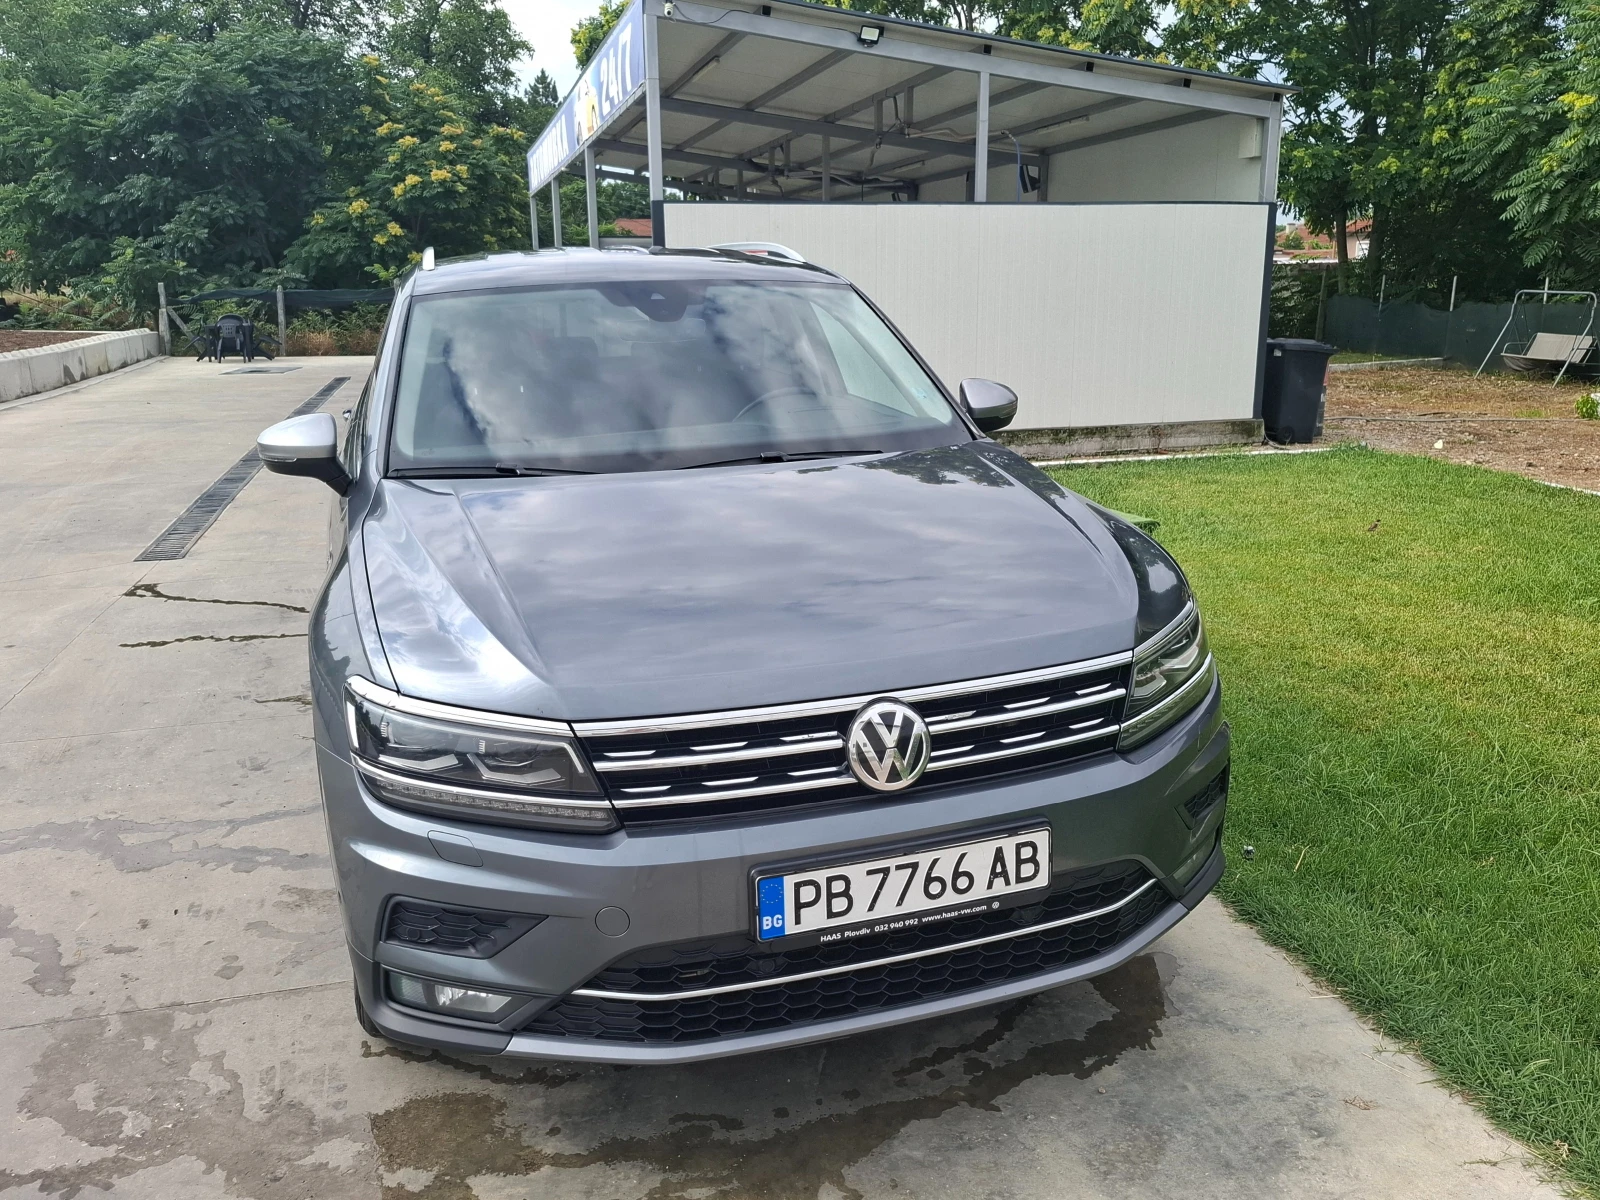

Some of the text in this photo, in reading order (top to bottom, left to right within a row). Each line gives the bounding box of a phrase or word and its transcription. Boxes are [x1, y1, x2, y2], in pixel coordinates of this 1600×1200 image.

[600, 22, 632, 117] 24/7
[793, 840, 1041, 926] PB 7766 AB
[762, 914, 783, 930] BG
[820, 932, 842, 943] HAAS
[844, 927, 871, 938] Plovdiv
[874, 923, 889, 932] 032
[889, 920, 904, 931] 940
[904, 917, 919, 927] 992
[921, 904, 987, 923] www.haas-vw.com
